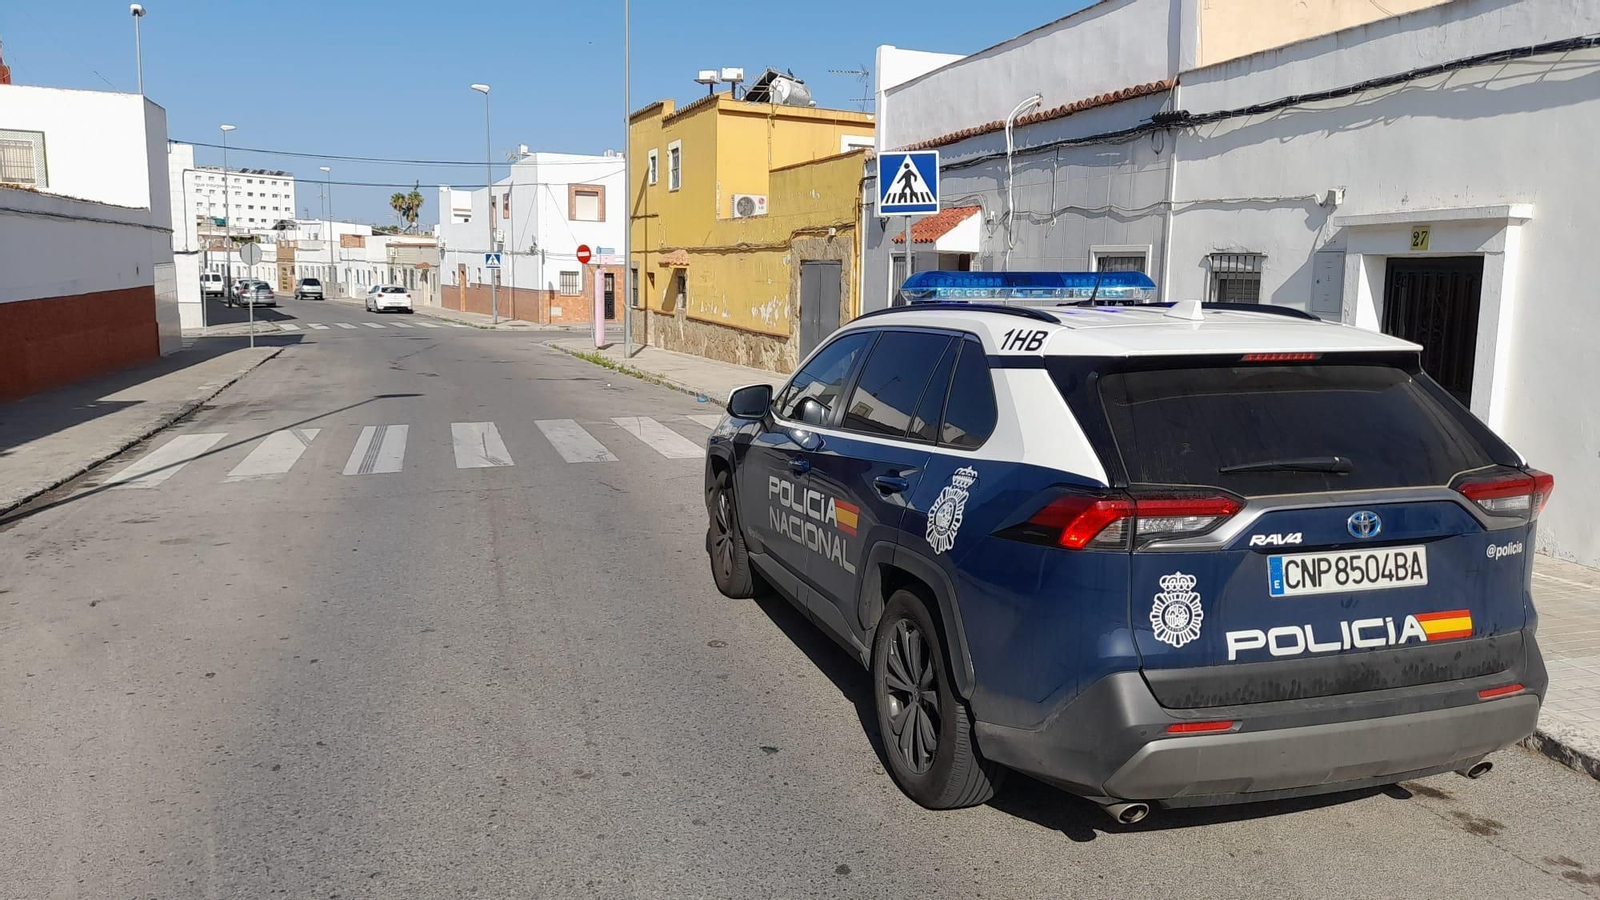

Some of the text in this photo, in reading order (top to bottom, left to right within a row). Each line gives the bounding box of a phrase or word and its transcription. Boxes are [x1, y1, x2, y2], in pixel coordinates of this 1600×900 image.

[1412, 230, 1428, 247] 27
[1000, 328, 1049, 351] 1HB
[769, 505, 855, 575] NACIONAL
[1249, 532, 1303, 547] RAV4
[1486, 541, 1522, 560] @policia
[1274, 579, 1281, 589] E
